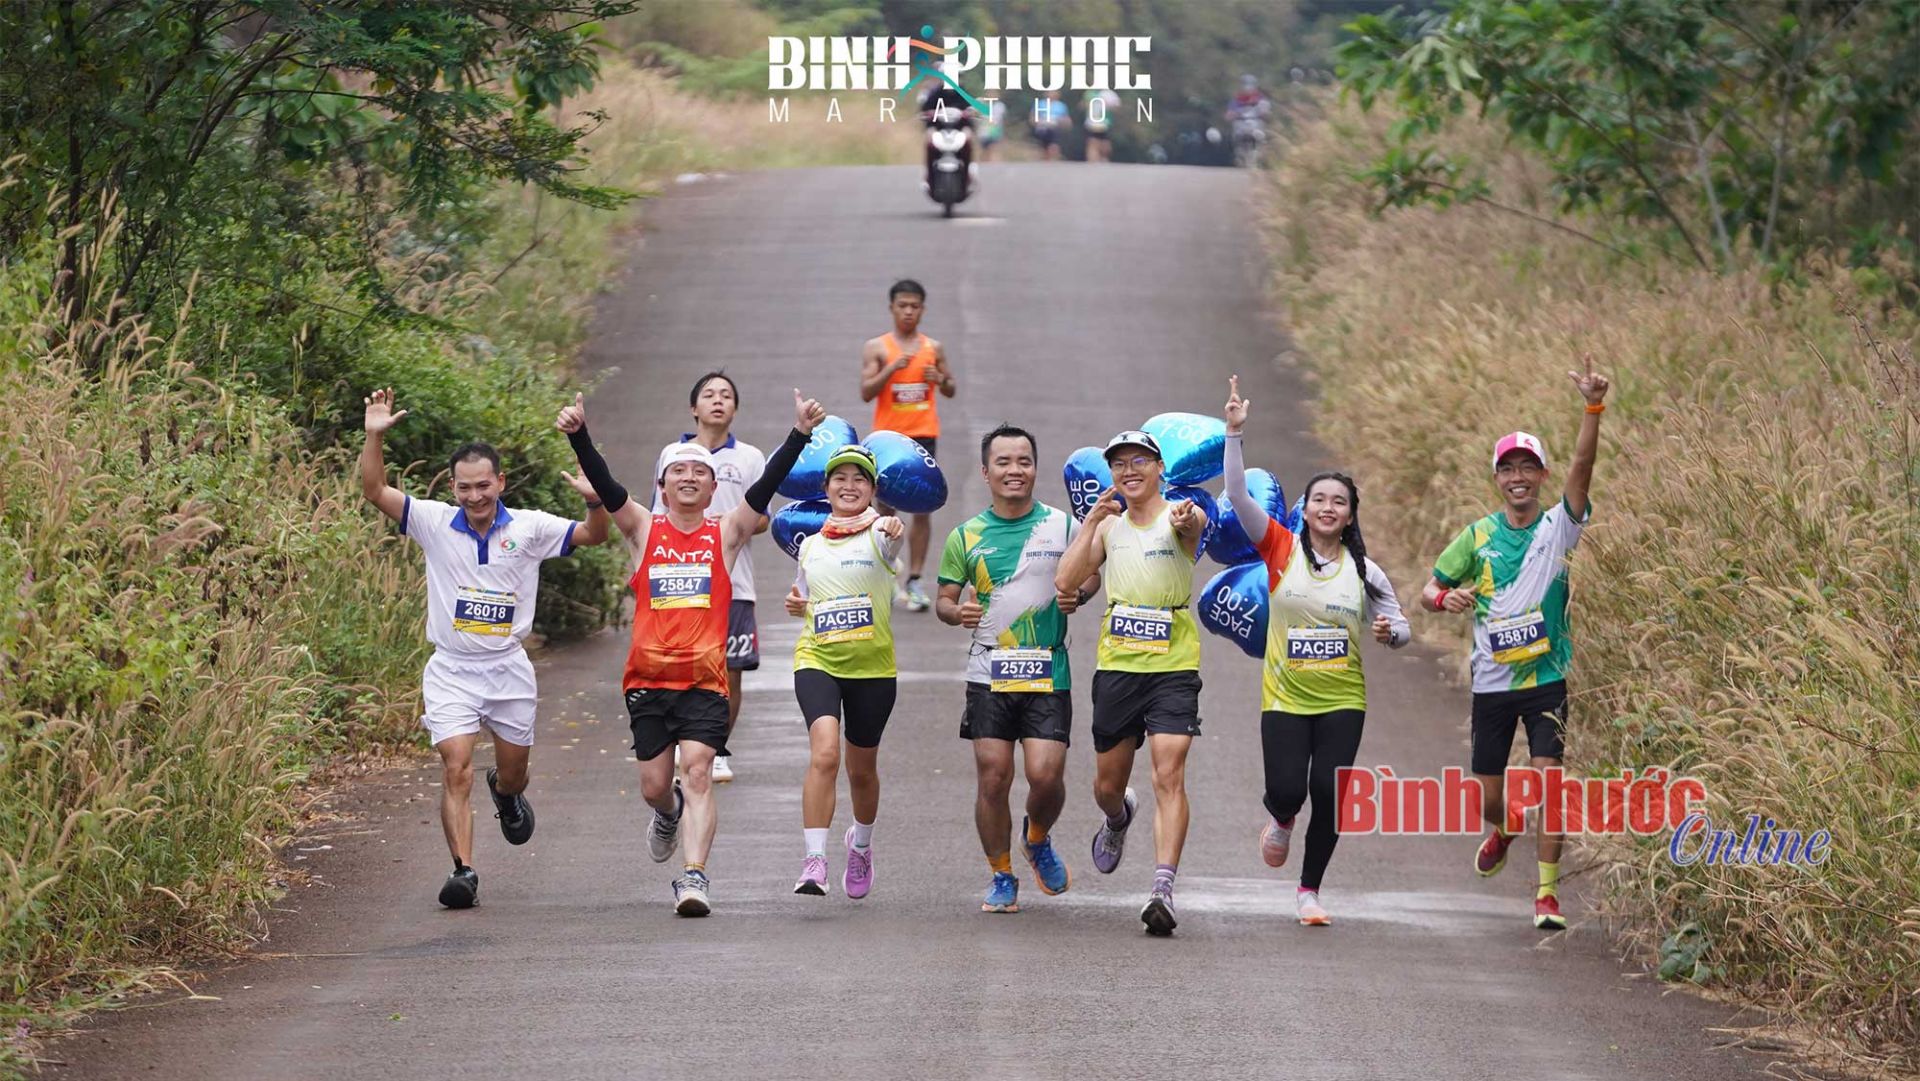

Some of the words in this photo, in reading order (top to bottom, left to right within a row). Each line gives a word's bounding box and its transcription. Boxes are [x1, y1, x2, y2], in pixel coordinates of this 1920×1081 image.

[653, 545, 714, 562] ANTA
[659, 578, 703, 592] 25847
[464, 602, 507, 619] 26018
[1217, 585, 1259, 622] 7:00
[817, 608, 870, 629] PACER
[1114, 618, 1167, 637] PACER
[1209, 604, 1252, 639] PACE
[1497, 625, 1538, 646] 25870
[1292, 641, 1345, 655] PACER
[1000, 661, 1043, 675] 25732
